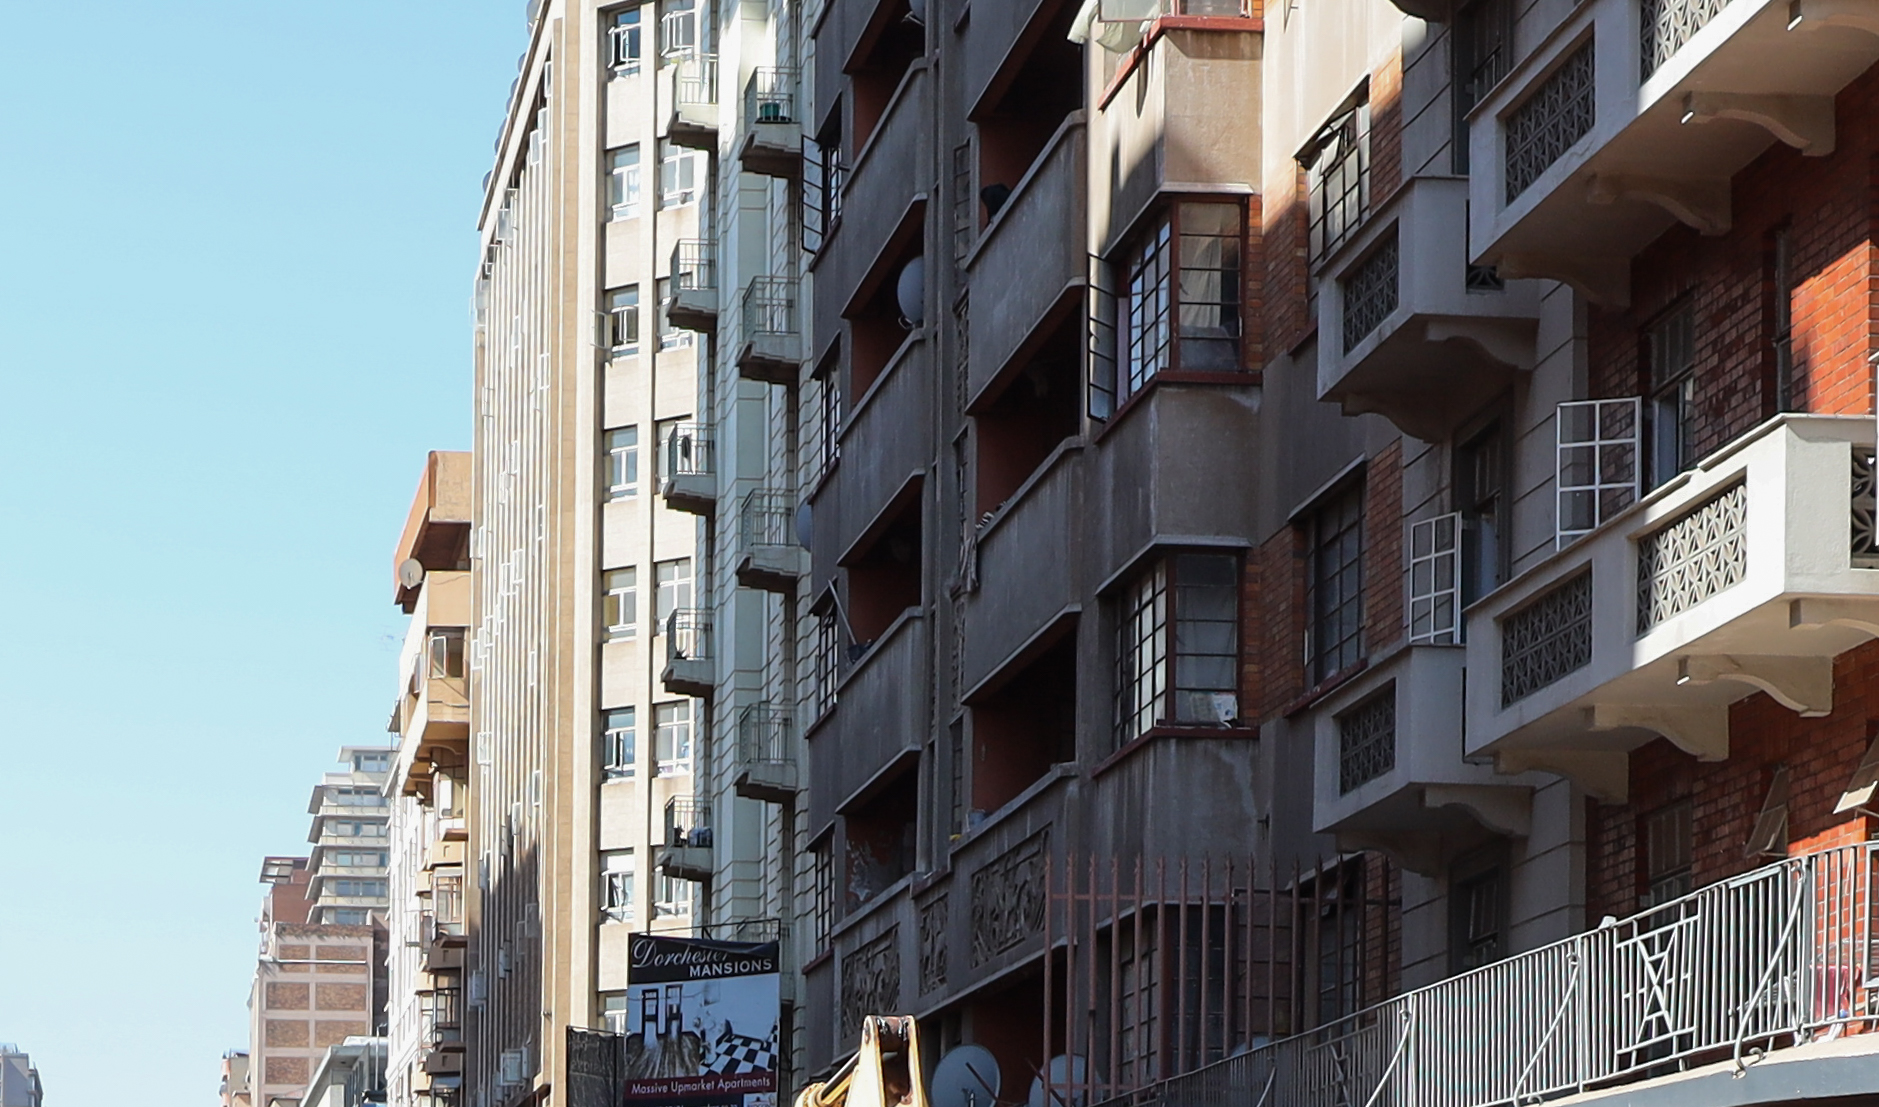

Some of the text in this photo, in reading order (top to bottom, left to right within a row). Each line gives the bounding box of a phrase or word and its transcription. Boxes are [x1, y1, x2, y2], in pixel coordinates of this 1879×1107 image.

[689, 958, 772, 978] MANSIONS
[631, 1077, 771, 1096] Massive Upmarket Apartments
